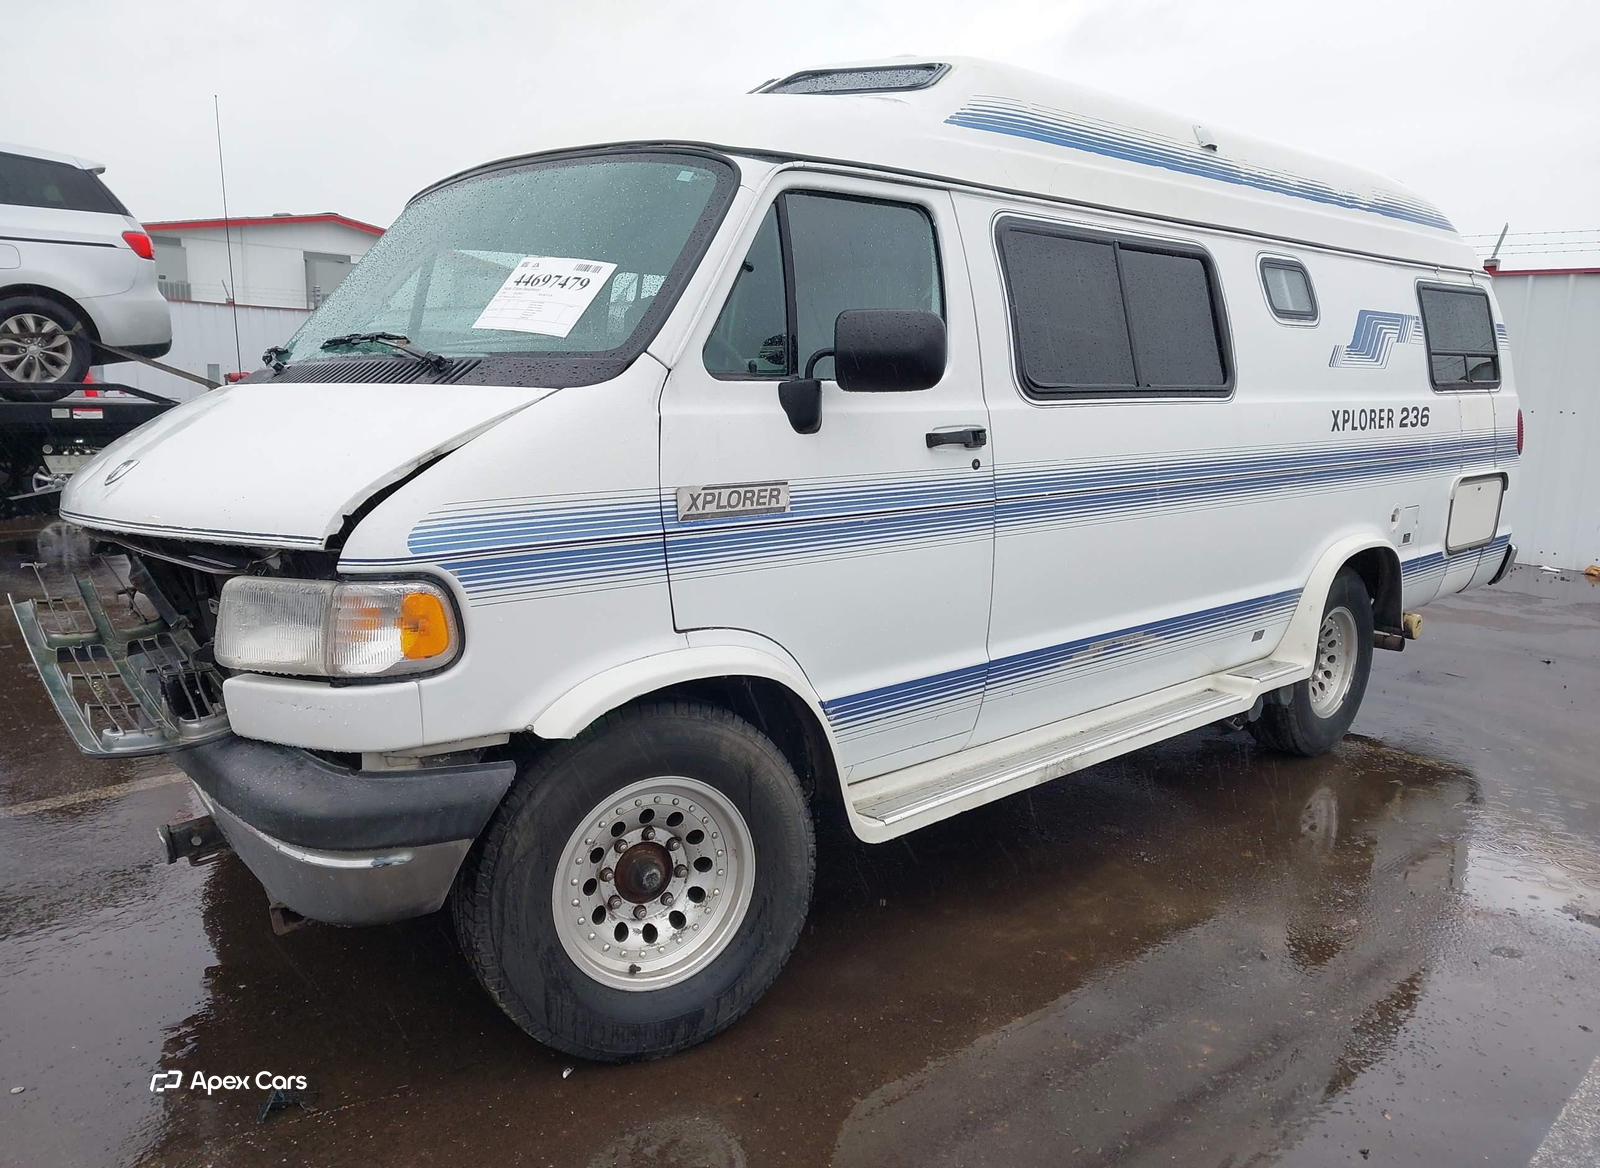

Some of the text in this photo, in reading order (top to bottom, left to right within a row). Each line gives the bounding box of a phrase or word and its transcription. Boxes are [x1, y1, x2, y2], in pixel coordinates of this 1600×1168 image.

[515, 273, 590, 291] 44697479
[1331, 406, 1430, 432] XPLORER 236
[687, 488, 781, 512] XPLORER
